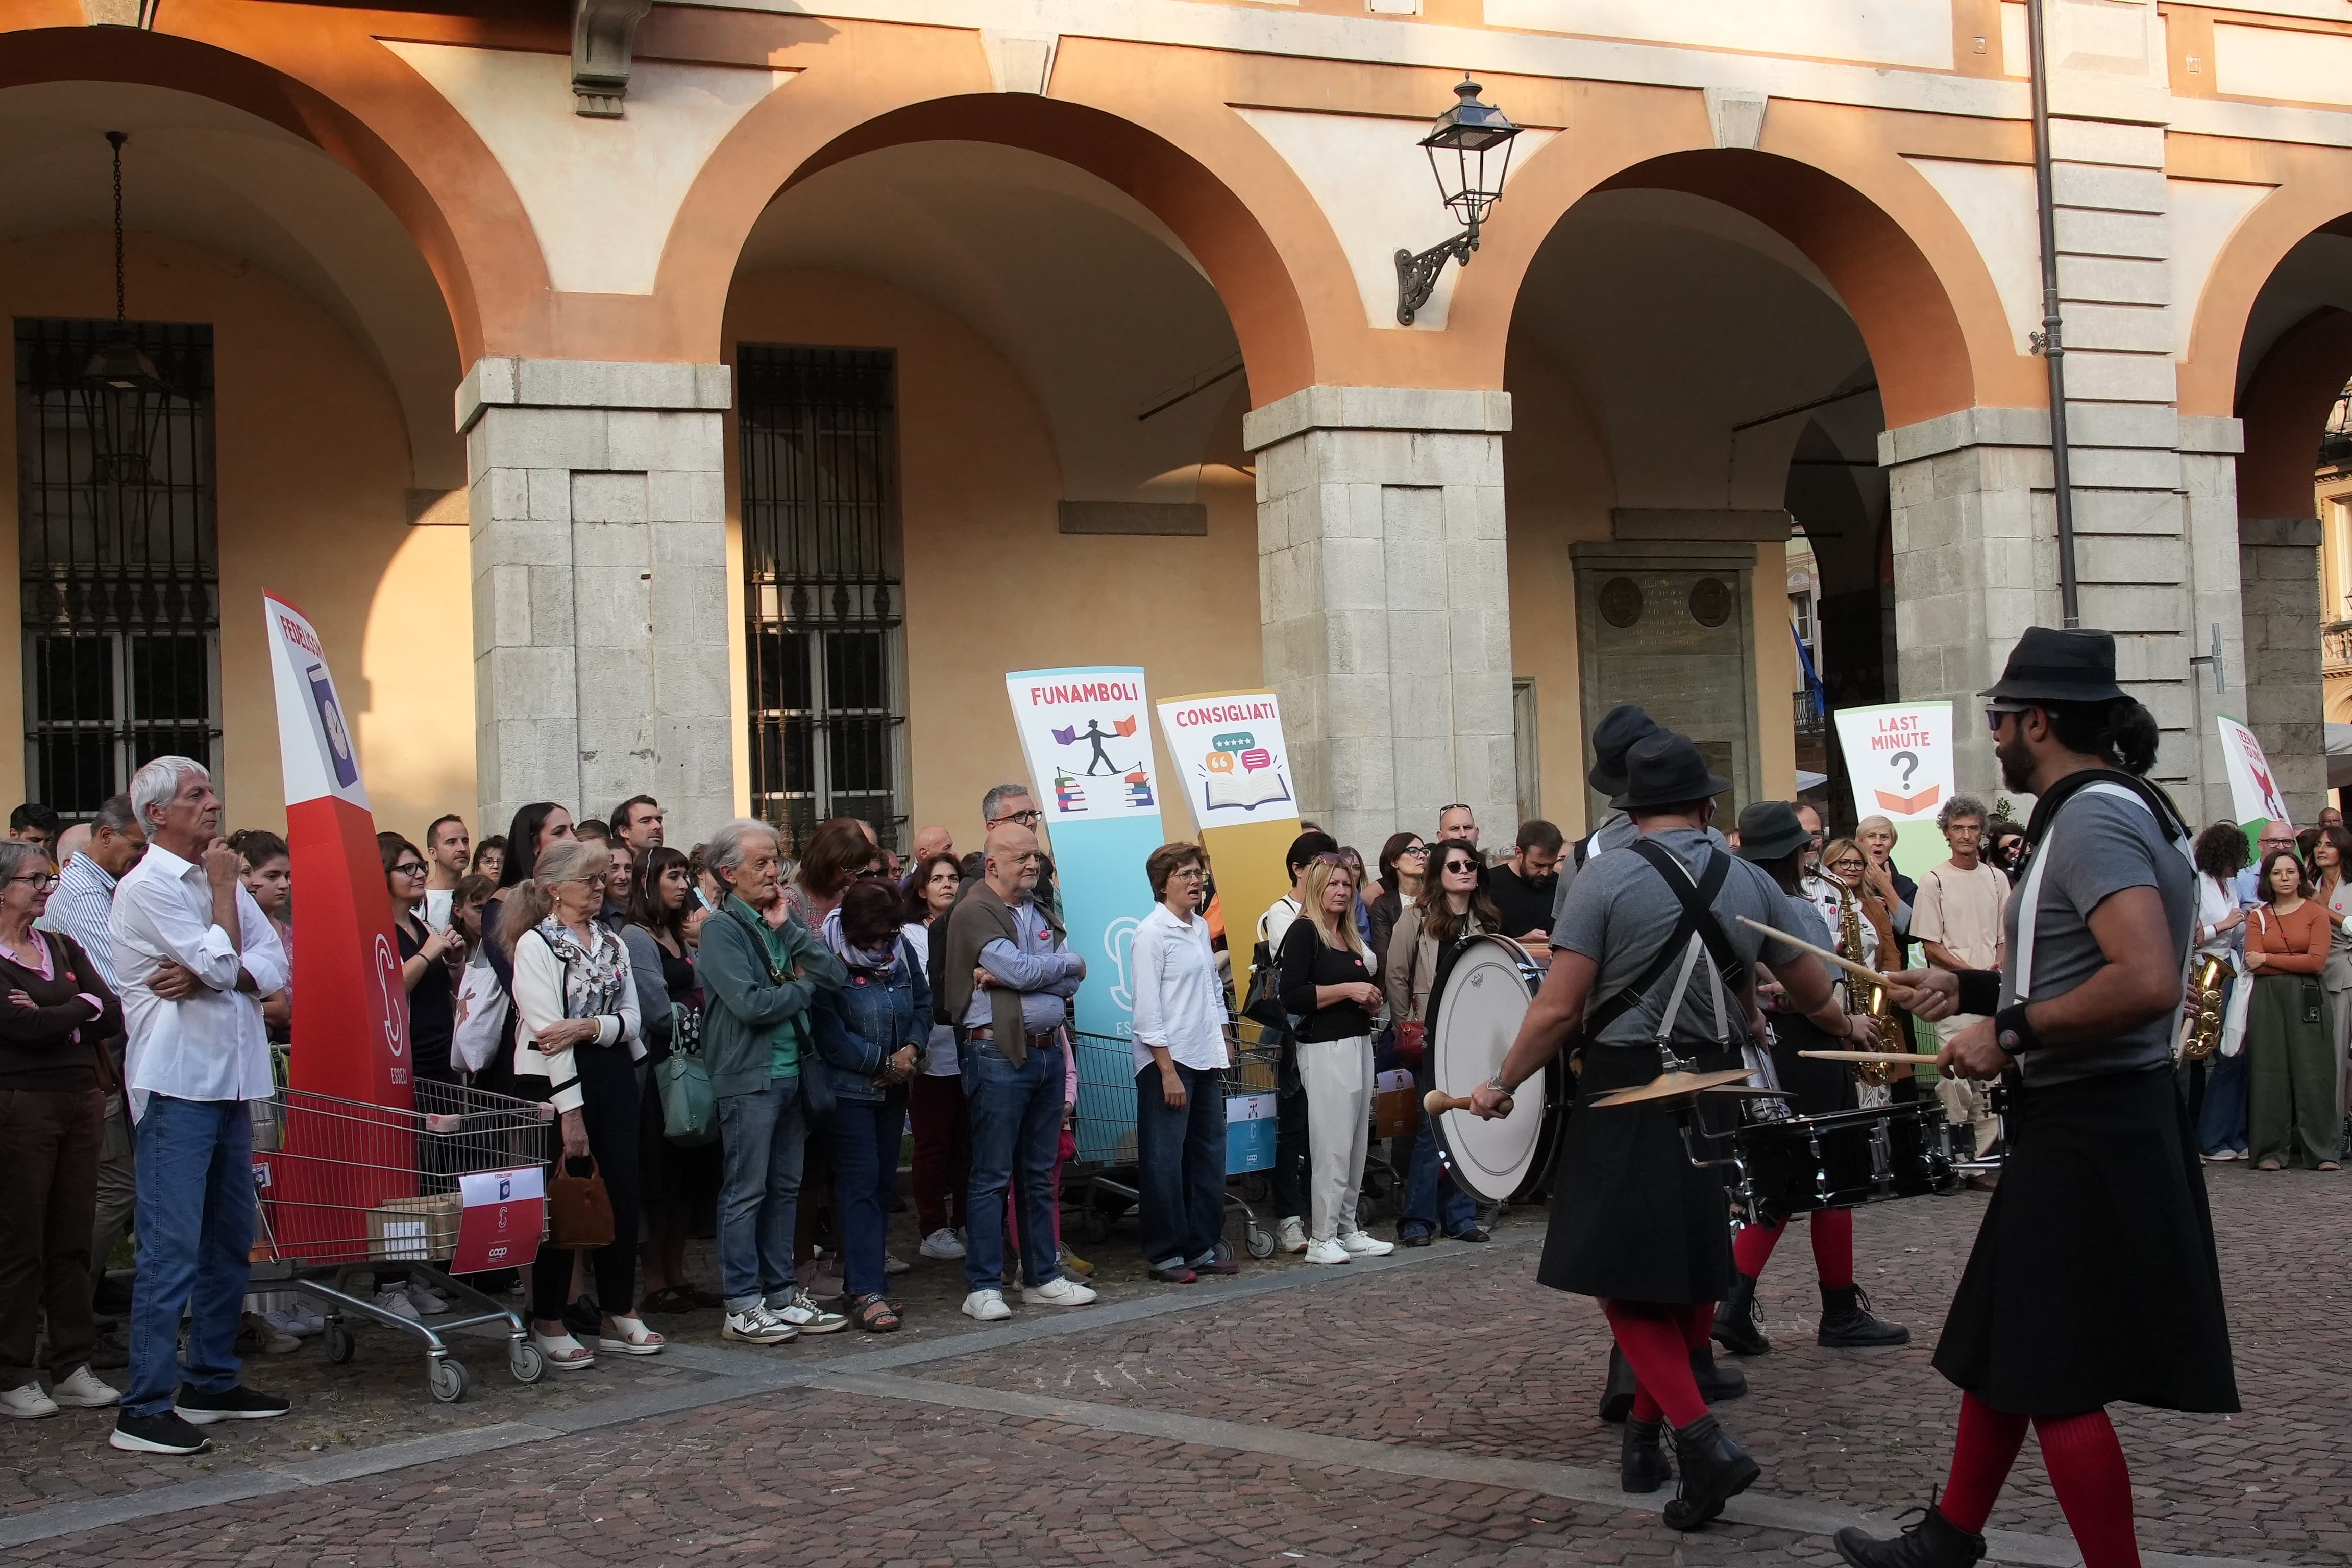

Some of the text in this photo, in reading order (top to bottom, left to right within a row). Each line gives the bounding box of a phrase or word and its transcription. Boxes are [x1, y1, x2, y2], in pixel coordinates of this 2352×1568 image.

[1031, 683, 1138, 706] FUNAMBOLI
[1177, 703, 1275, 727] CONSIGLIATI
[1879, 716, 1918, 732] LAST
[1871, 732, 1930, 750] MINUTE
[390, 1068, 408, 1084] ESSECI
[489, 1247, 507, 1258] coop
